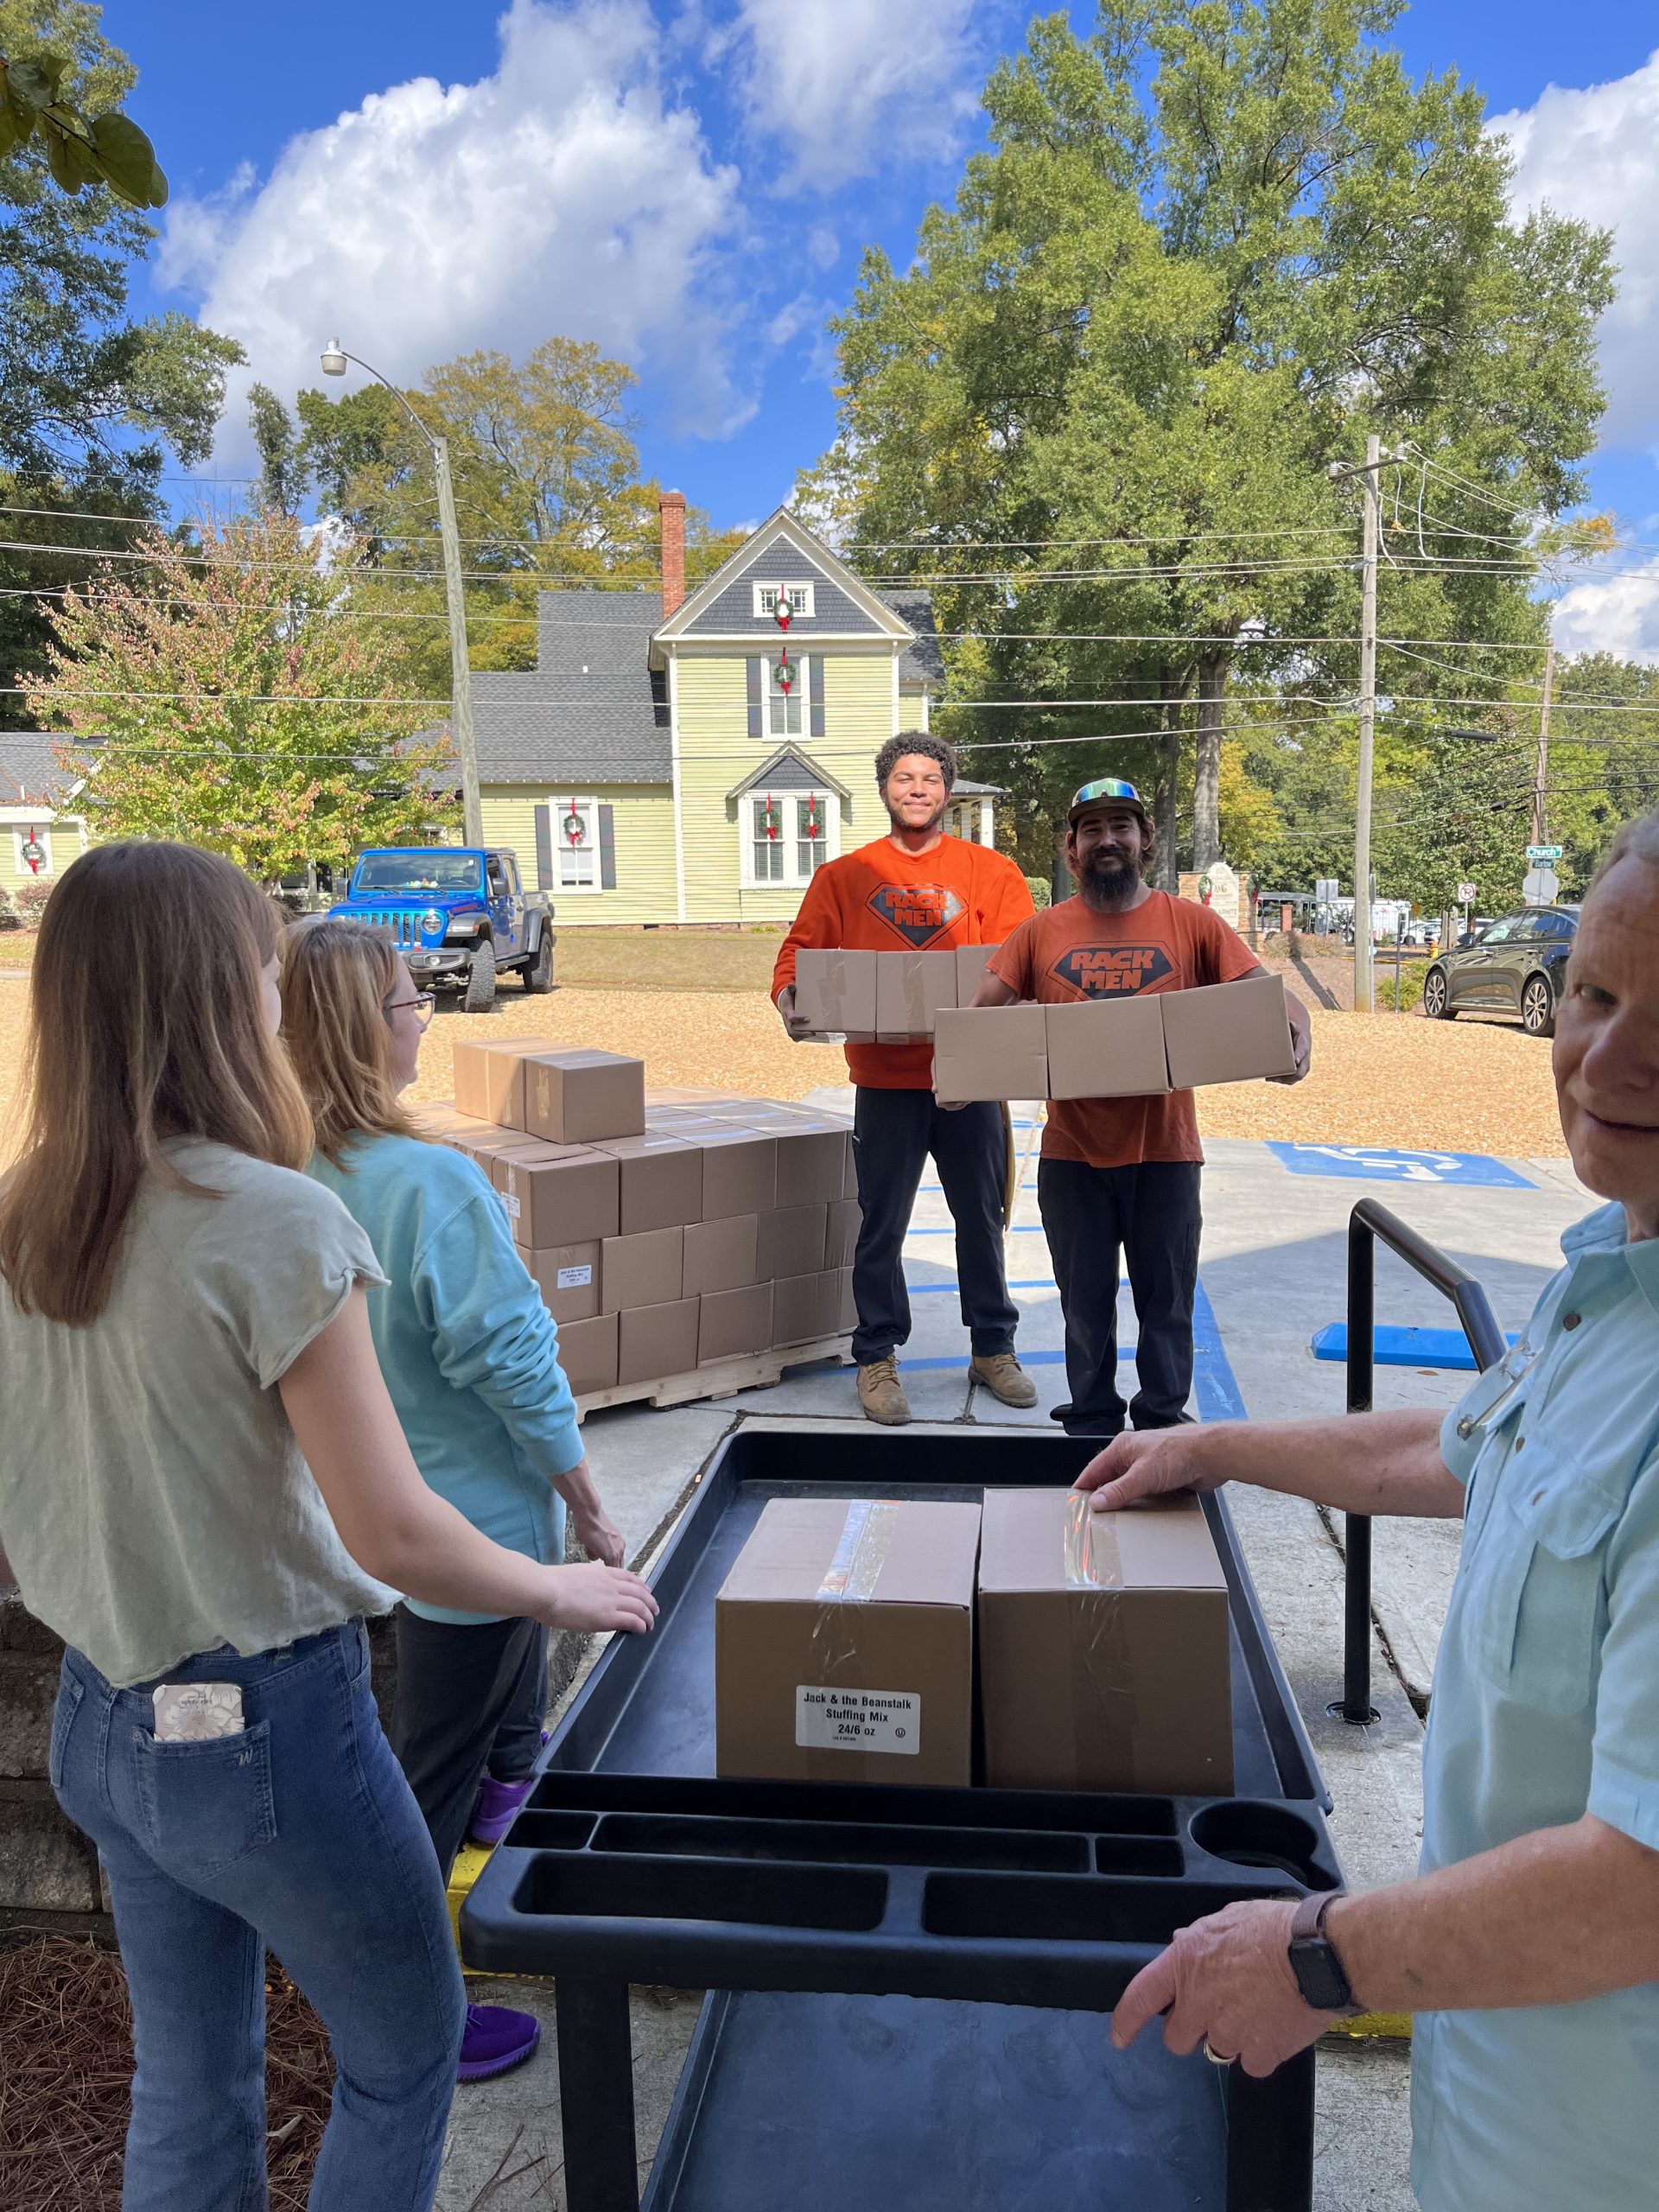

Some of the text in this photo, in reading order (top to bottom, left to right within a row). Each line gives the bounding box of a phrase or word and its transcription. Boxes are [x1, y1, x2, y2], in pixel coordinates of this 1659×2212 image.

[1528, 847, 1556, 856] Church
[885, 892, 947, 910] RACK
[894, 908, 942, 926] MEN
[1071, 950, 1155, 970] RACK
[1080, 969, 1142, 989] MEN
[804, 1693, 912, 1709] Jack & the Beanstalk
[826, 1708, 888, 1722] Stuffing Mix
[838, 1724, 861, 1735] 24/6
